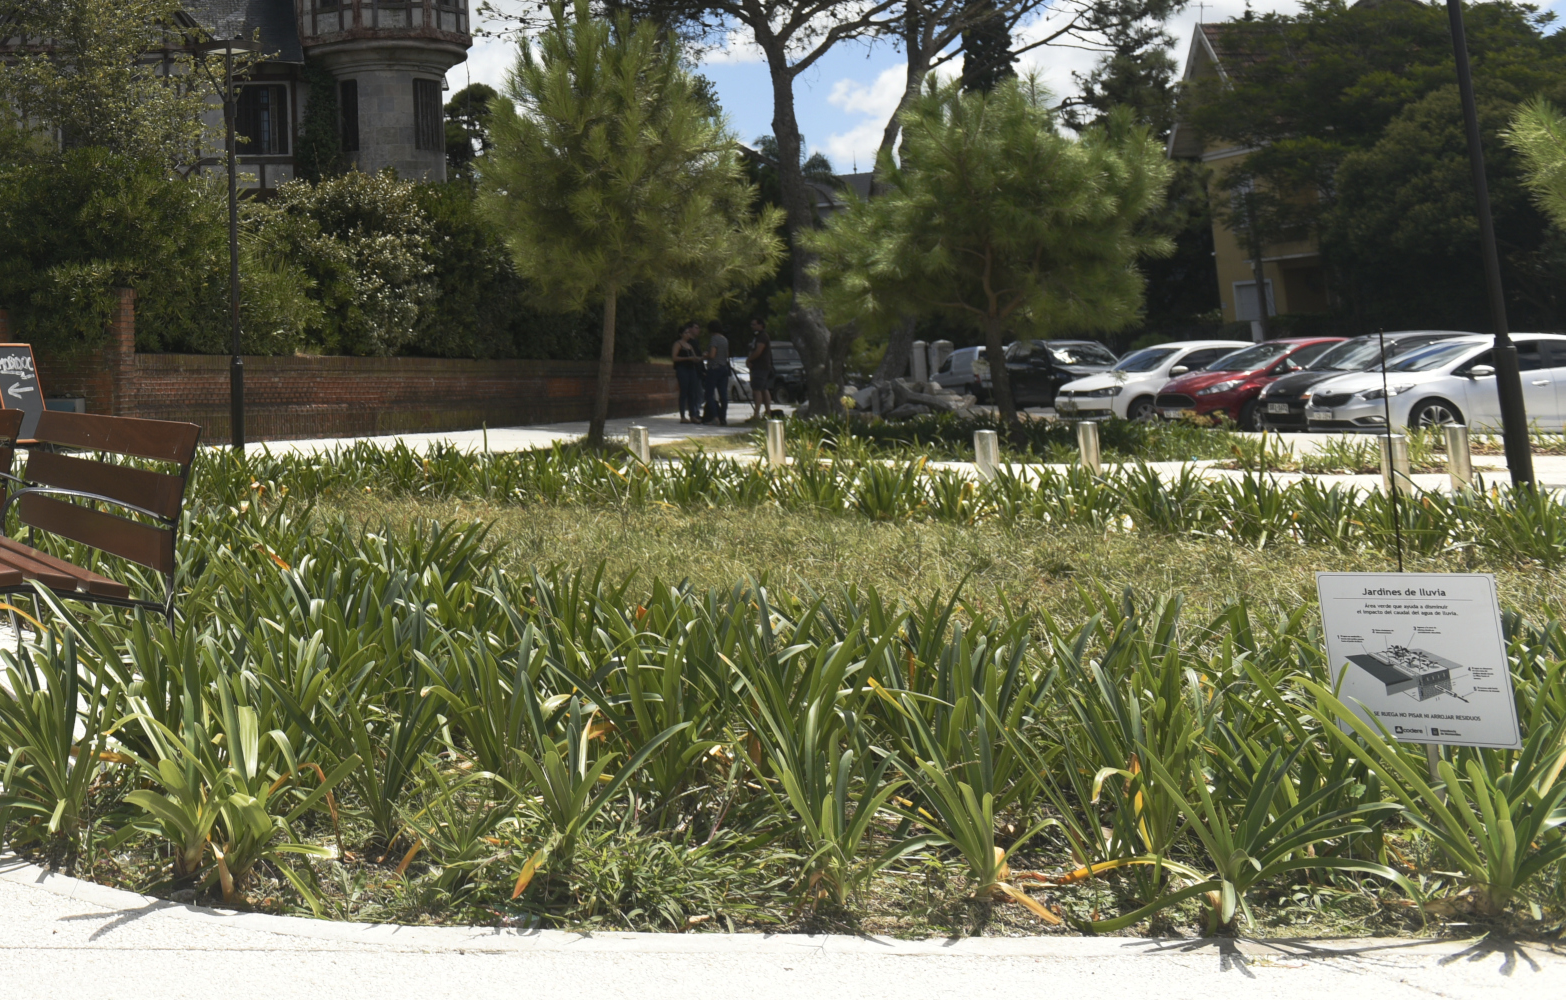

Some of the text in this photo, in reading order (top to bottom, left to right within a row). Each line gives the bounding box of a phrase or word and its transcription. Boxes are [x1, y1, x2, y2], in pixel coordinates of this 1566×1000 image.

[1362, 588, 1446, 597] Jardines de lluvia
